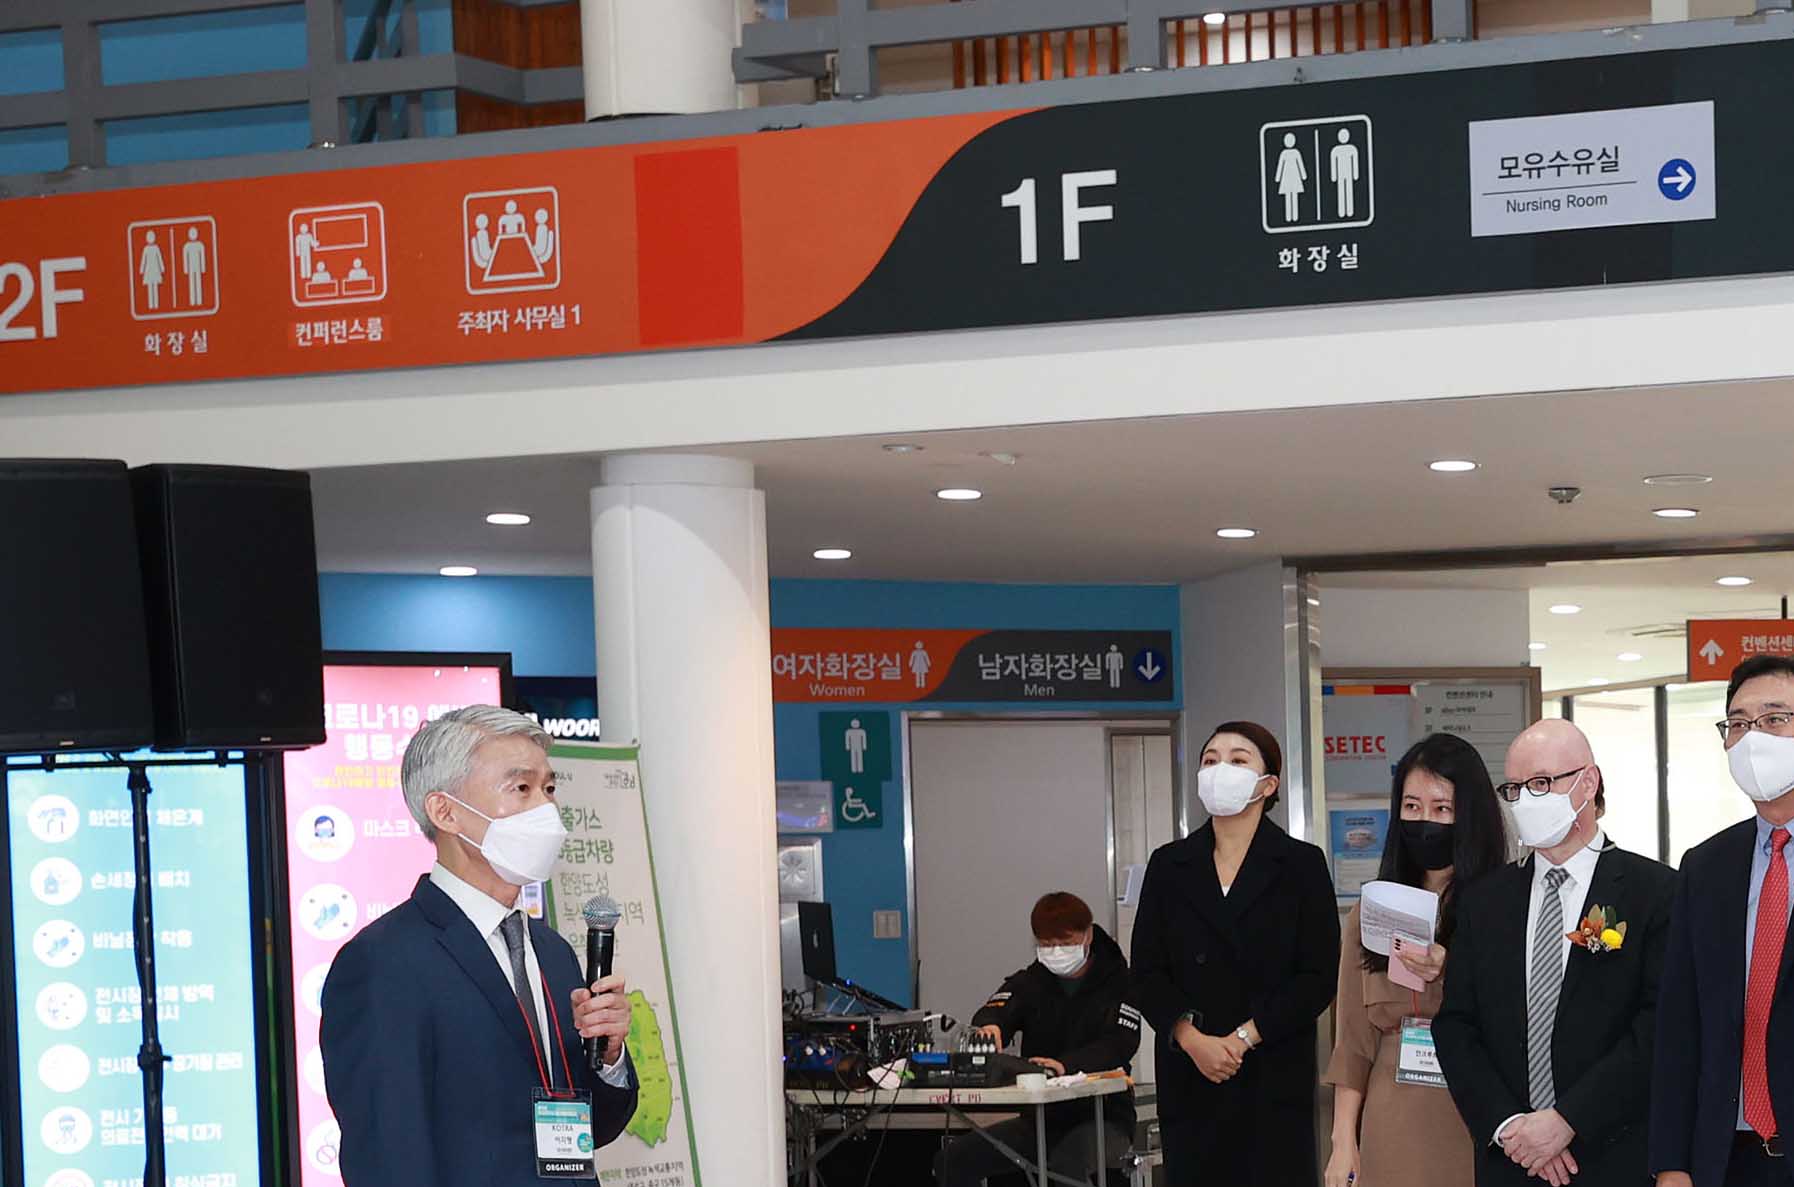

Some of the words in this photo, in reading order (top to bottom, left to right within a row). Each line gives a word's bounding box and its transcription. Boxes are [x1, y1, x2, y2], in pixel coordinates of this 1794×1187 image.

[1497, 145, 1621, 179] 모유수유실
[1505, 196, 1561, 214] Nursing
[1565, 190, 1608, 209] Room
[1001, 169, 1117, 265] 1F
[1278, 243, 1360, 273] 화장실
[0, 256, 87, 342] 2F
[295, 316, 384, 347] 컨퍼런스룸
[457, 308, 510, 336] 주최자
[513, 304, 566, 332] 사무실
[572, 303, 581, 325] 1
[144, 329, 208, 356] 화장실
[773, 652, 902, 681] 여자화장실
[978, 652, 1102, 681] 남자화장실
[808, 682, 865, 698] Women
[1023, 683, 1055, 697] Men
[1323, 735, 1387, 754] SETEC
[560, 806, 603, 832] 출가스
[545, 1163, 585, 1172] ORGANIZER
